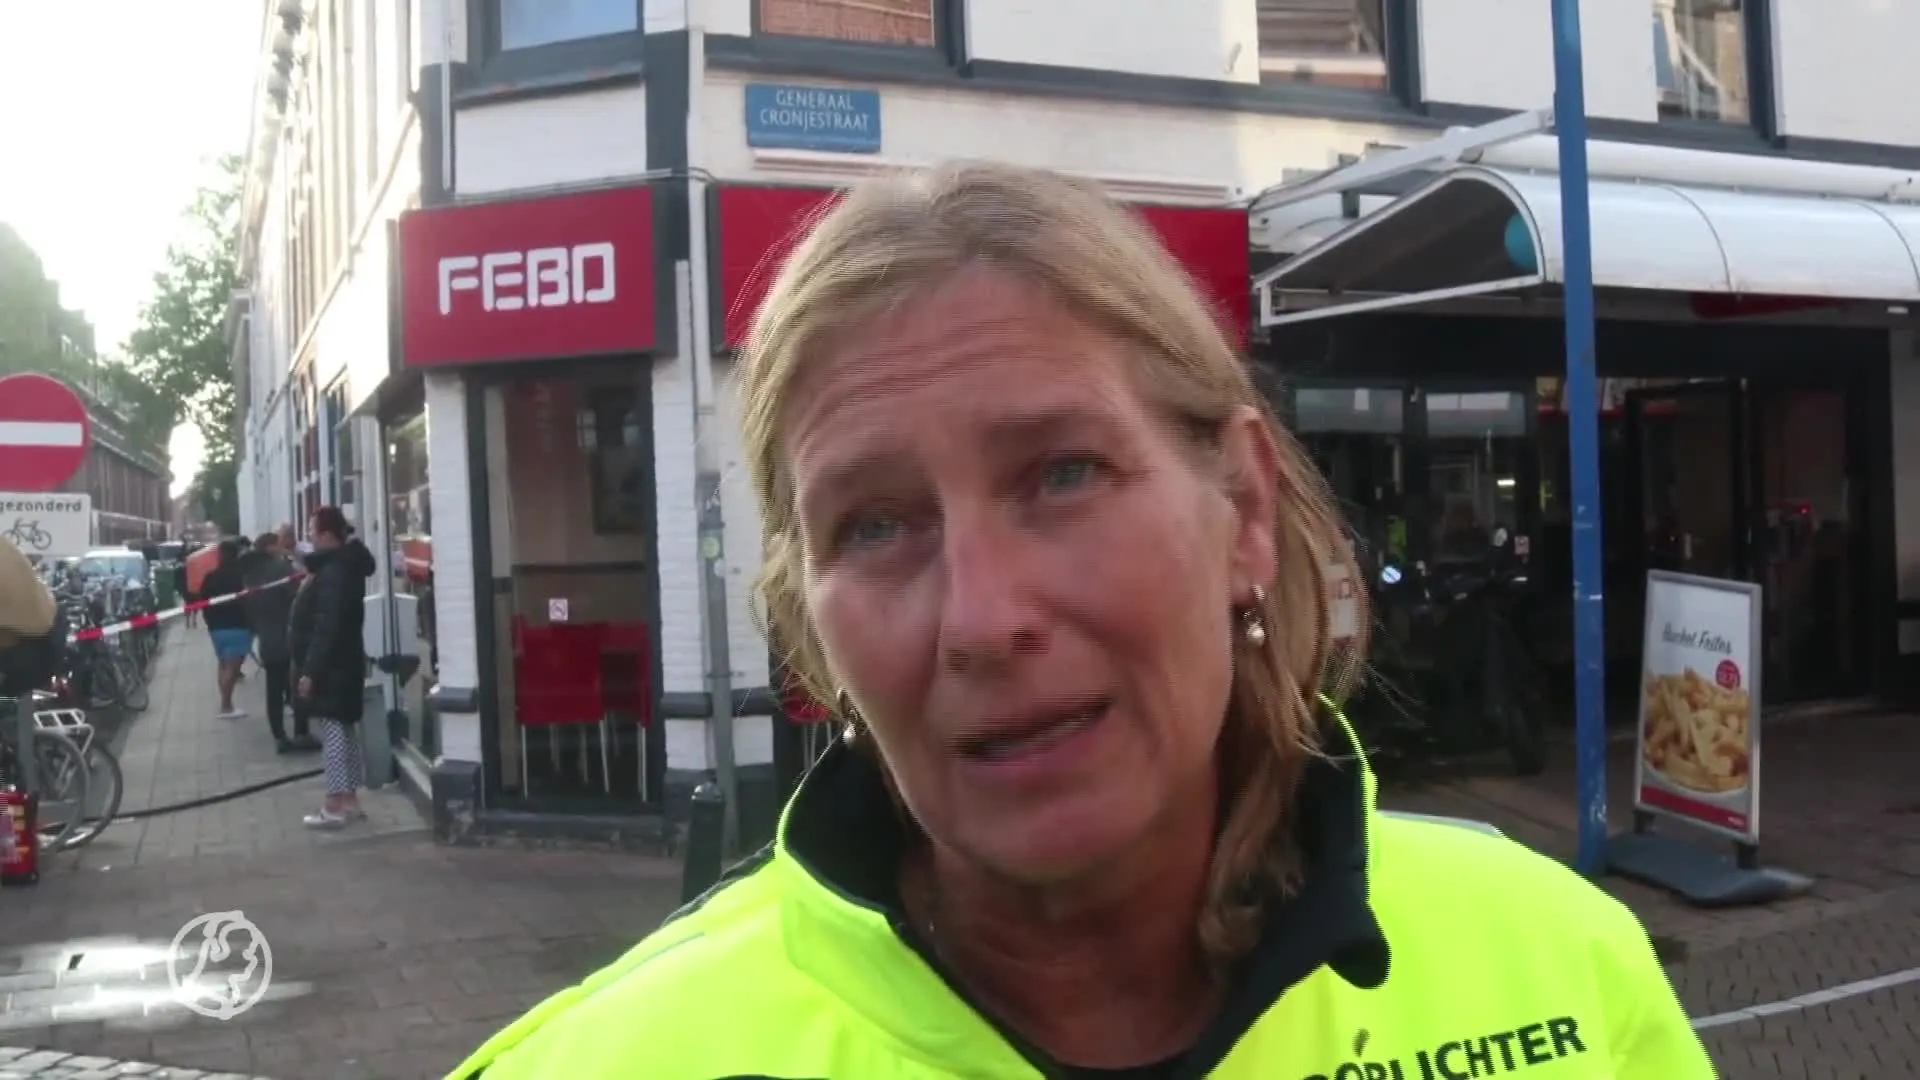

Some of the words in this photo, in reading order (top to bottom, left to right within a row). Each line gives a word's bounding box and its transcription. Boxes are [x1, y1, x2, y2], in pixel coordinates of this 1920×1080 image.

[775, 88, 854, 110] GENERAAL
[760, 107, 869, 132] CRONJESTRAAT
[438, 242, 615, 315] FEBO
